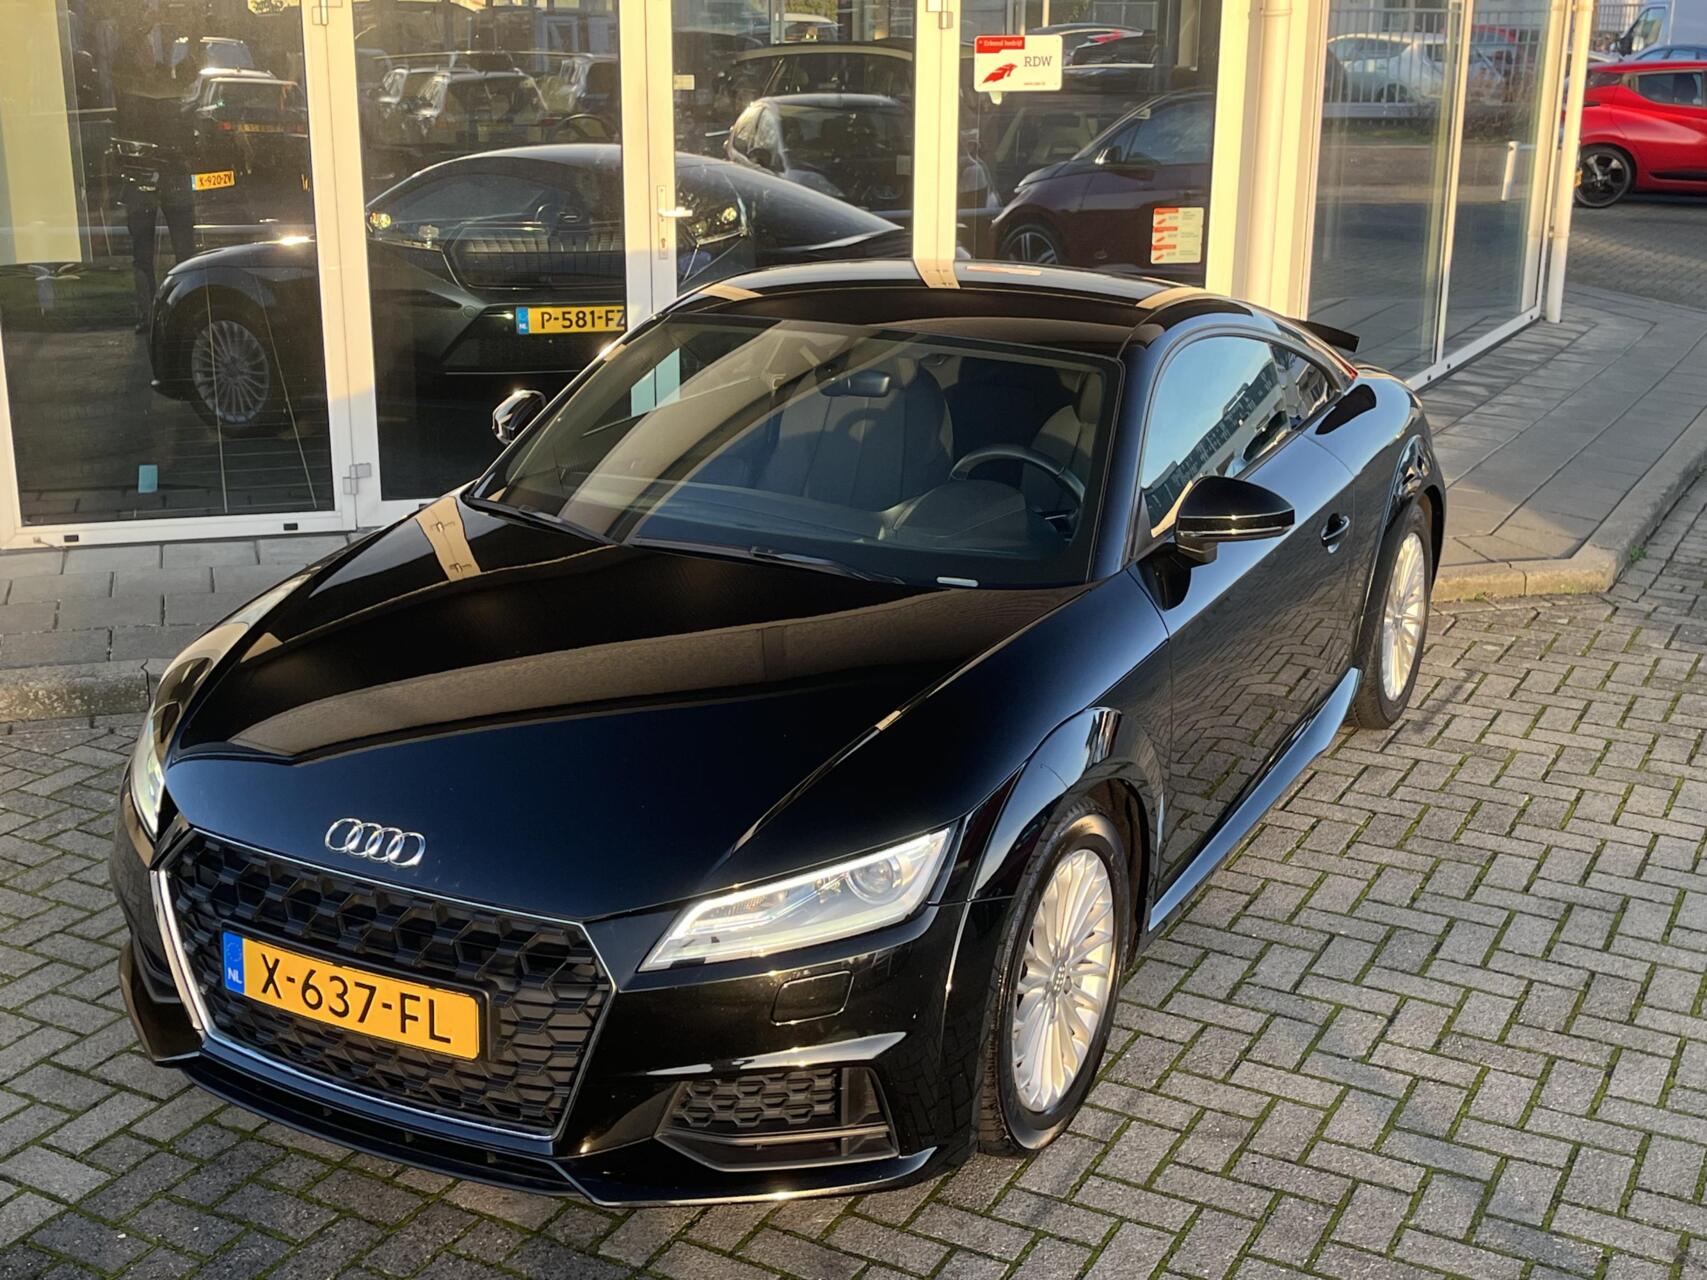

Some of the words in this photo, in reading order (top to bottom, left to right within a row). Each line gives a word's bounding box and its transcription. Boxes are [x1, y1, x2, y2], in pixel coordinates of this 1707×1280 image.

[1024, 56, 1053, 67] RDW
[541, 305, 625, 329] P-581-FZ
[227, 967, 243, 985] NL
[260, 953, 452, 1045] X-637-FL
